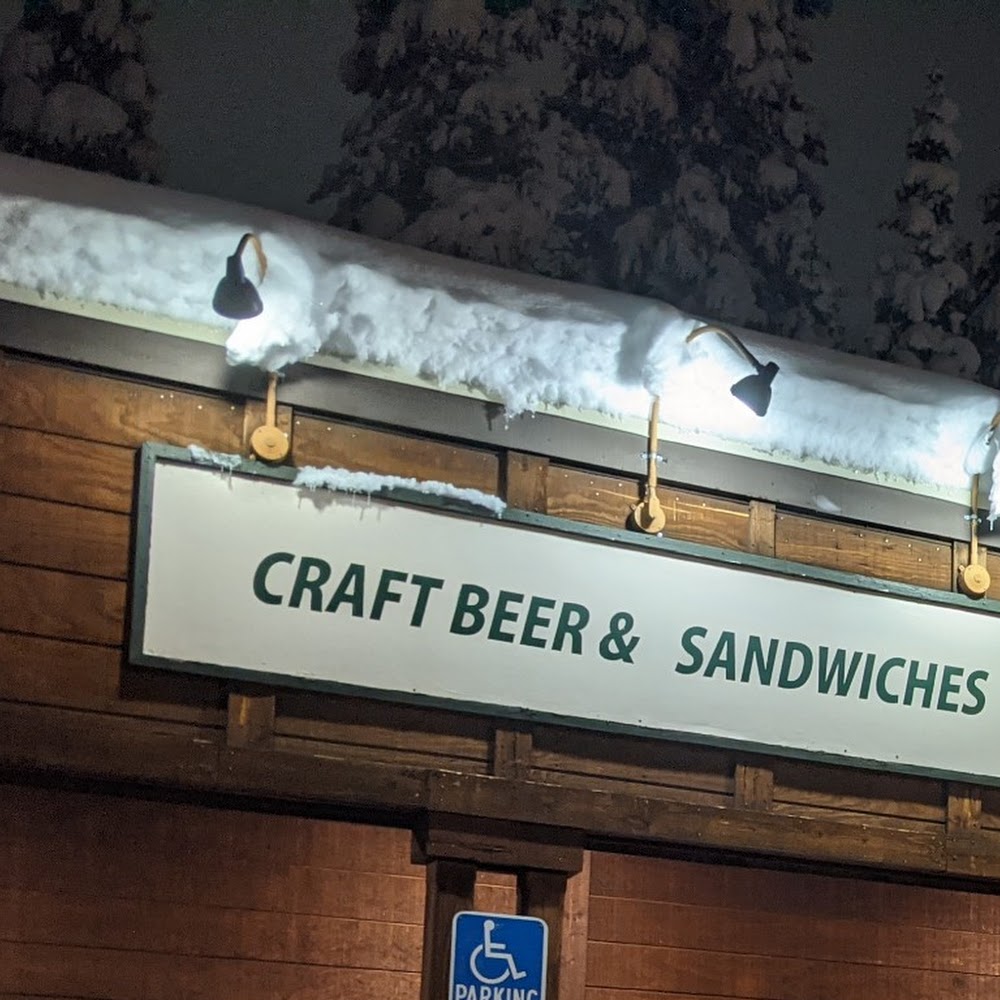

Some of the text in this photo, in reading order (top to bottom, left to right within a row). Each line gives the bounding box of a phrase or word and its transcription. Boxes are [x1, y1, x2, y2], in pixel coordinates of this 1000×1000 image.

[252, 551, 989, 716] CRAFT BEER & SANDWICHES
